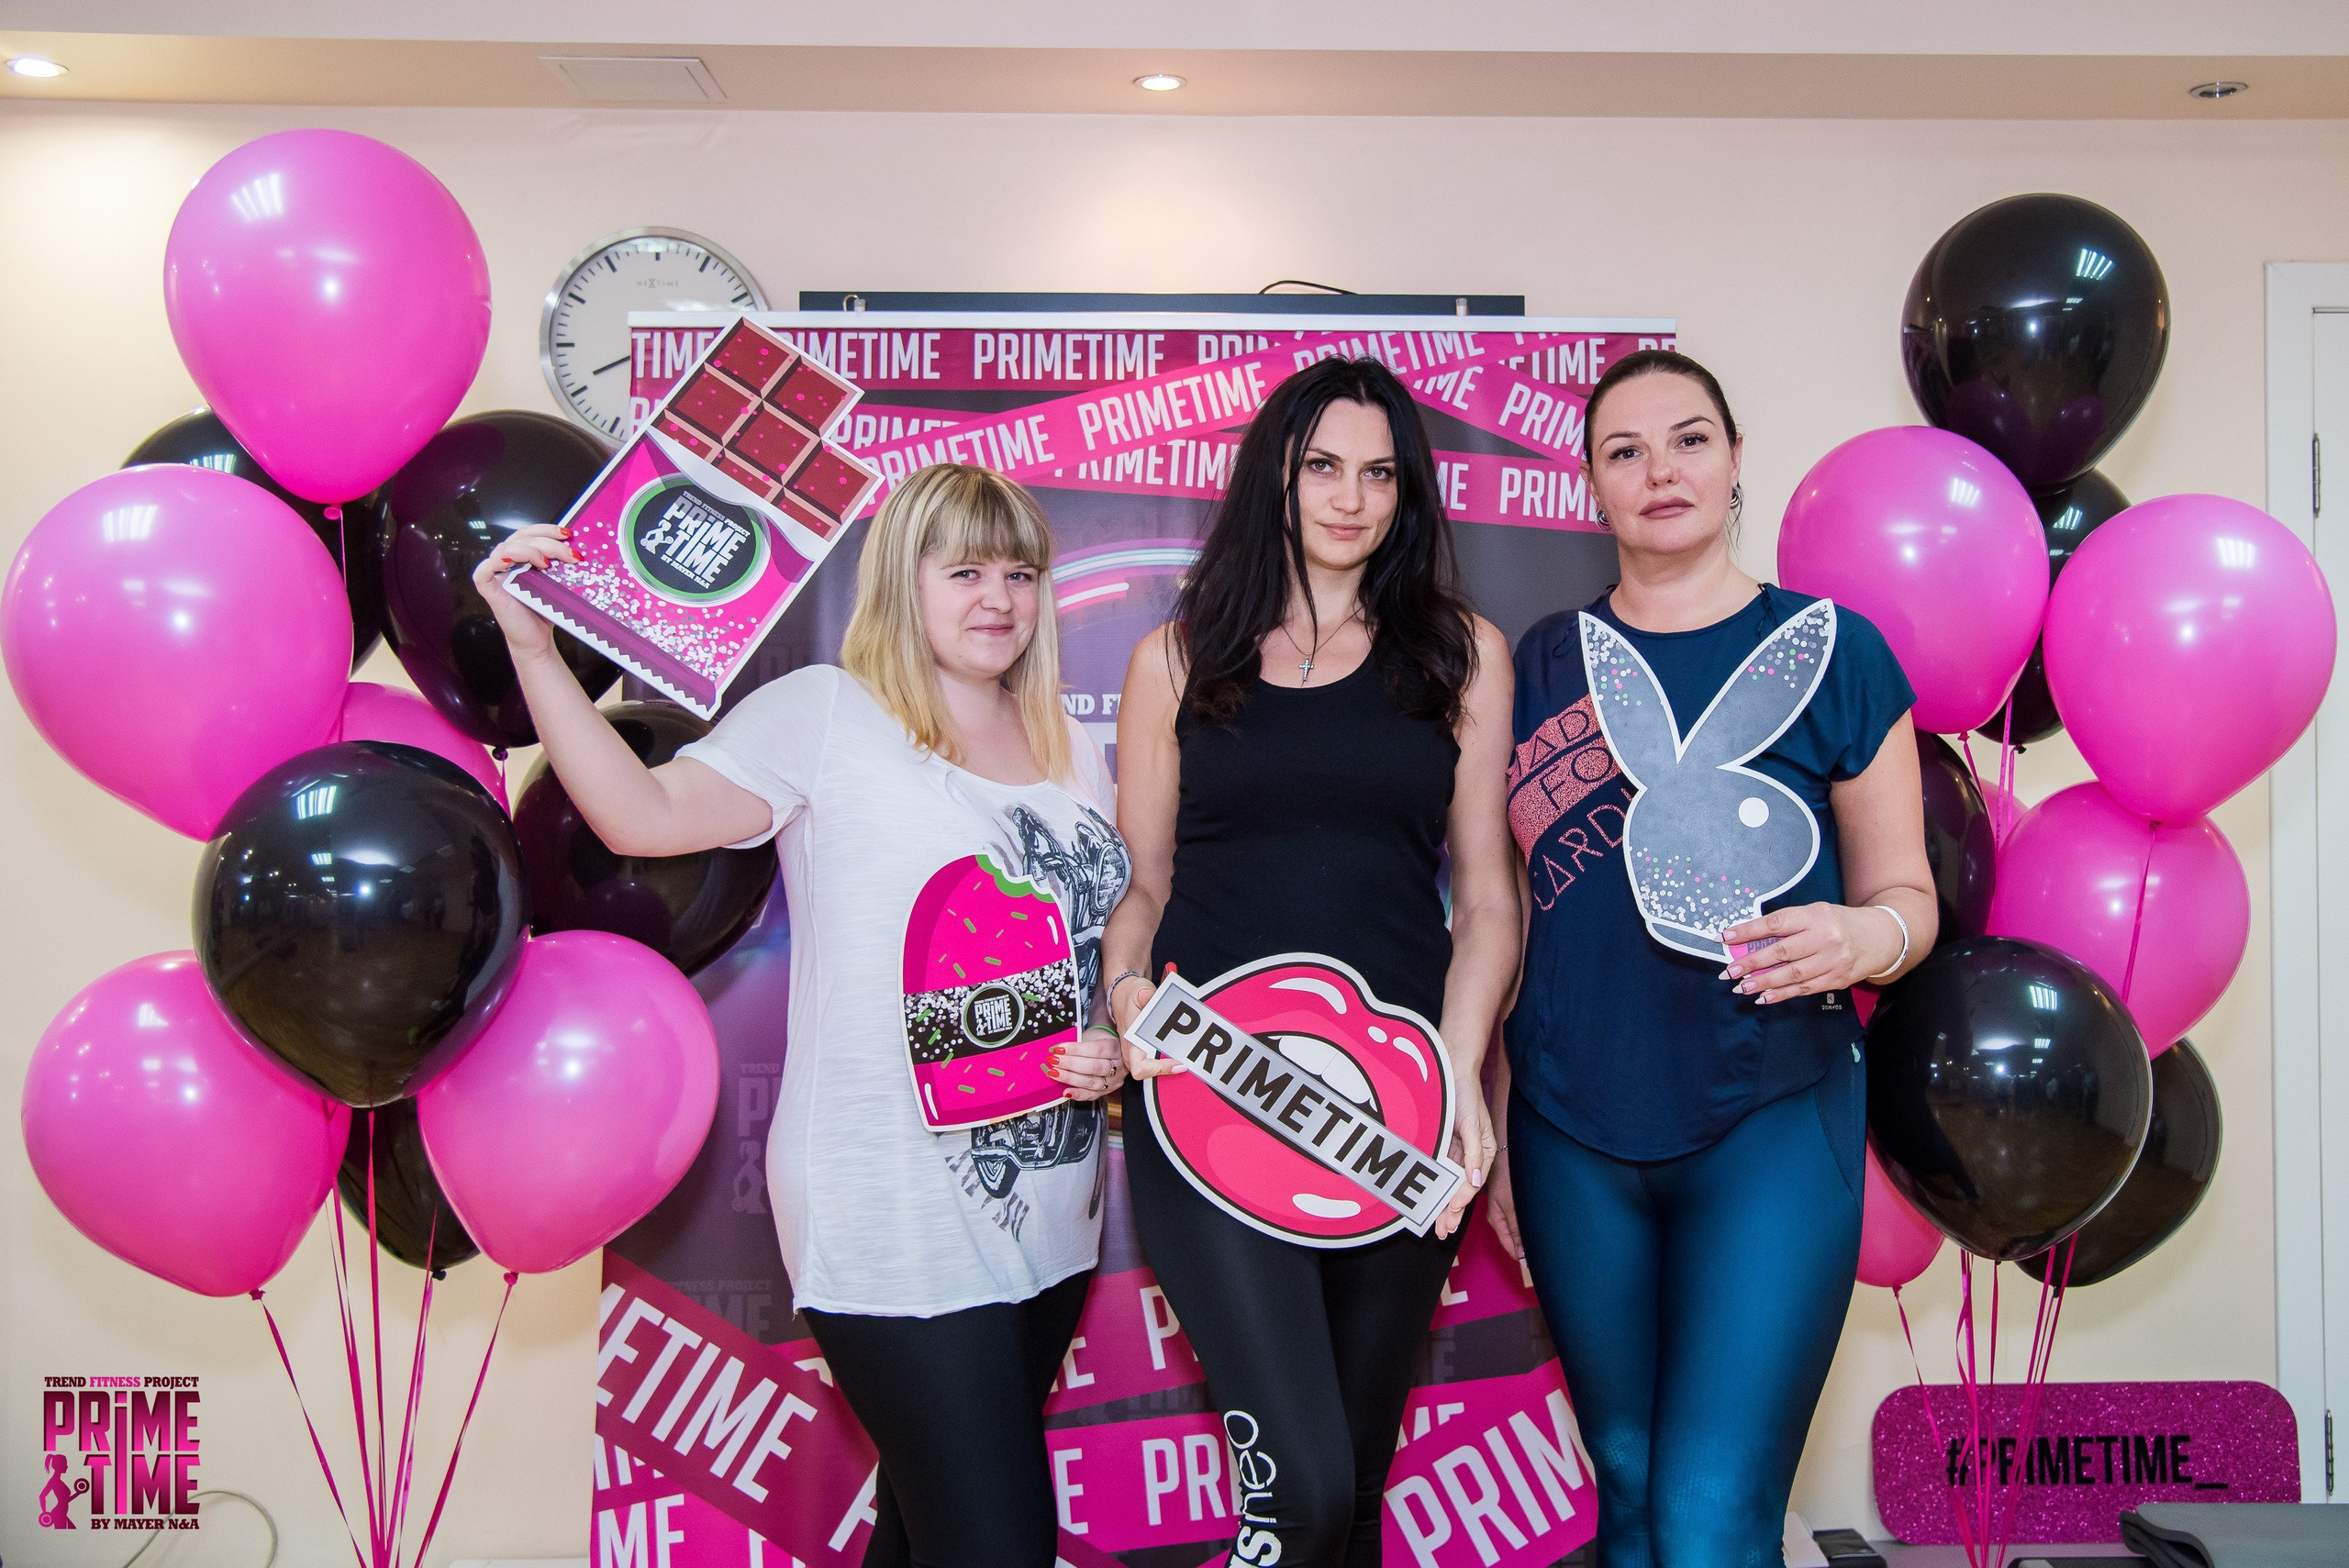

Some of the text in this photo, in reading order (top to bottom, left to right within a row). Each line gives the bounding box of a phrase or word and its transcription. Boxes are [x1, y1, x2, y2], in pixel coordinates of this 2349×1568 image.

[974, 333, 1165, 381] PRIMETIME
[1077, 361, 1266, 451] PRIMETIME
[664, 528, 730, 584] TIME
[1155, 1000, 1439, 1210] PRIMETIME
